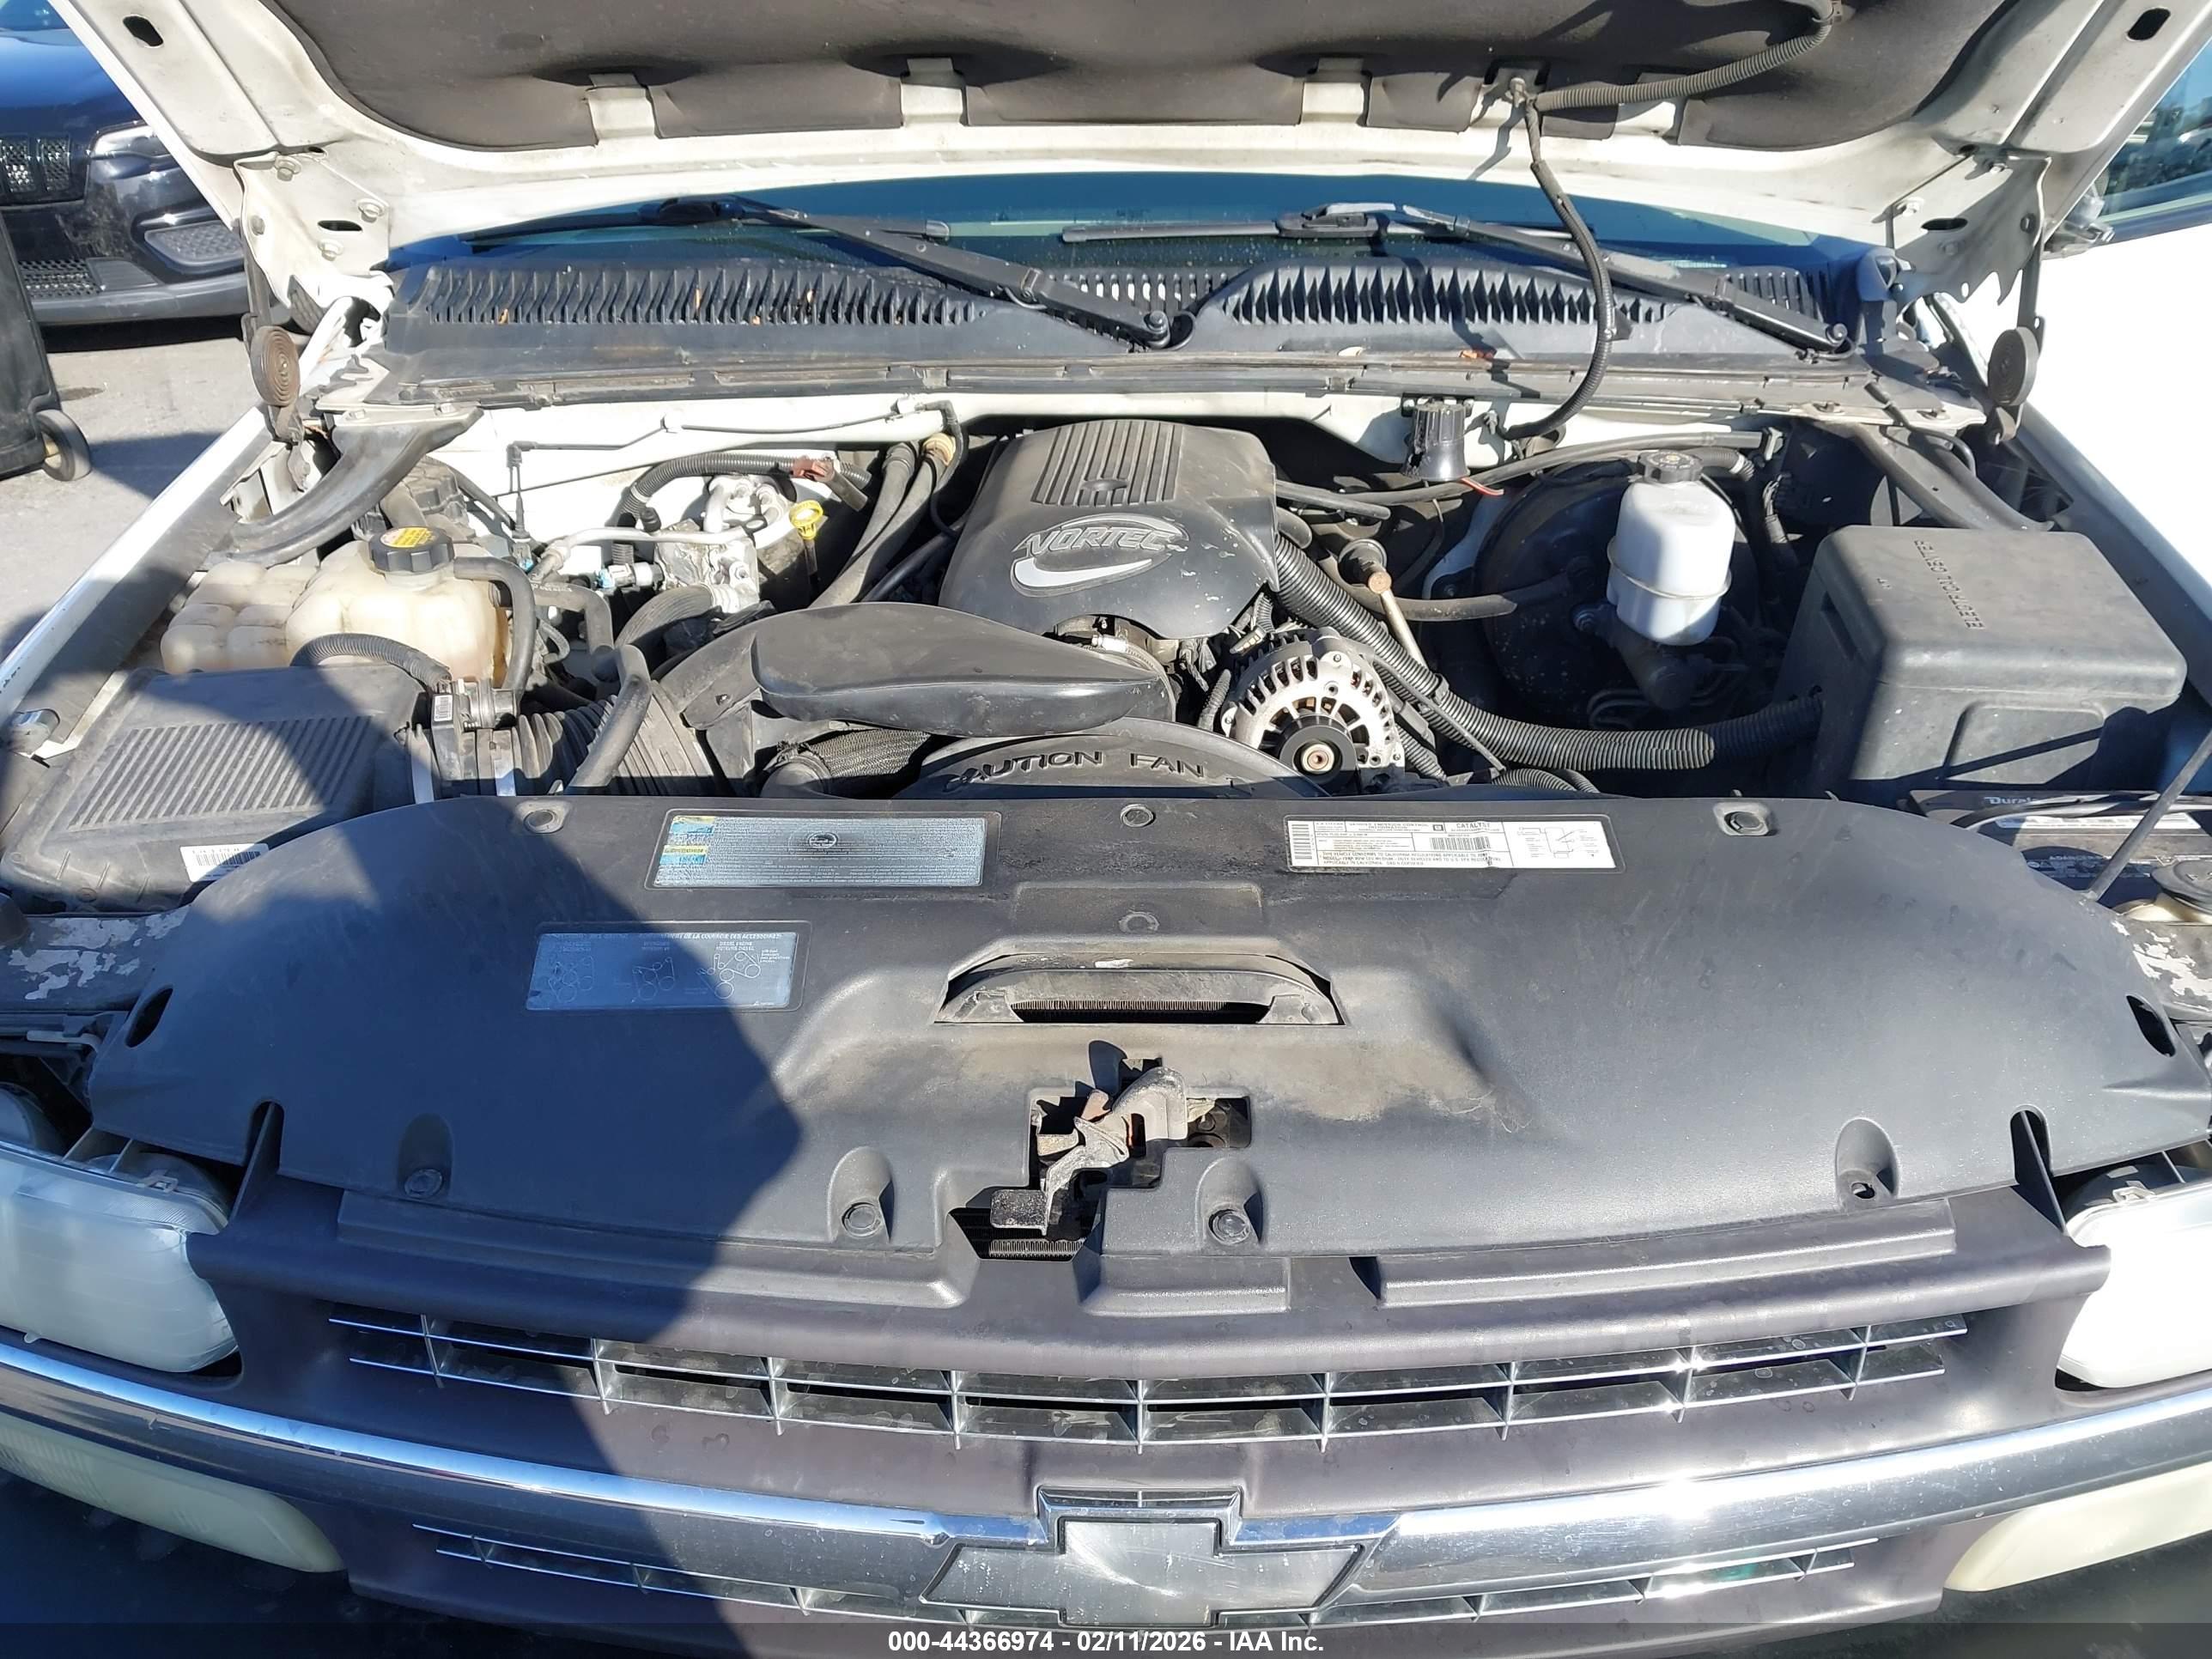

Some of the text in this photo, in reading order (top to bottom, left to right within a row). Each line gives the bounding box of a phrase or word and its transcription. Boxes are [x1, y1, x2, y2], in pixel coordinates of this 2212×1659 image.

[1012, 526, 1175, 557] VORTEC
[943, 750, 1204, 793] CAUTION FAN
